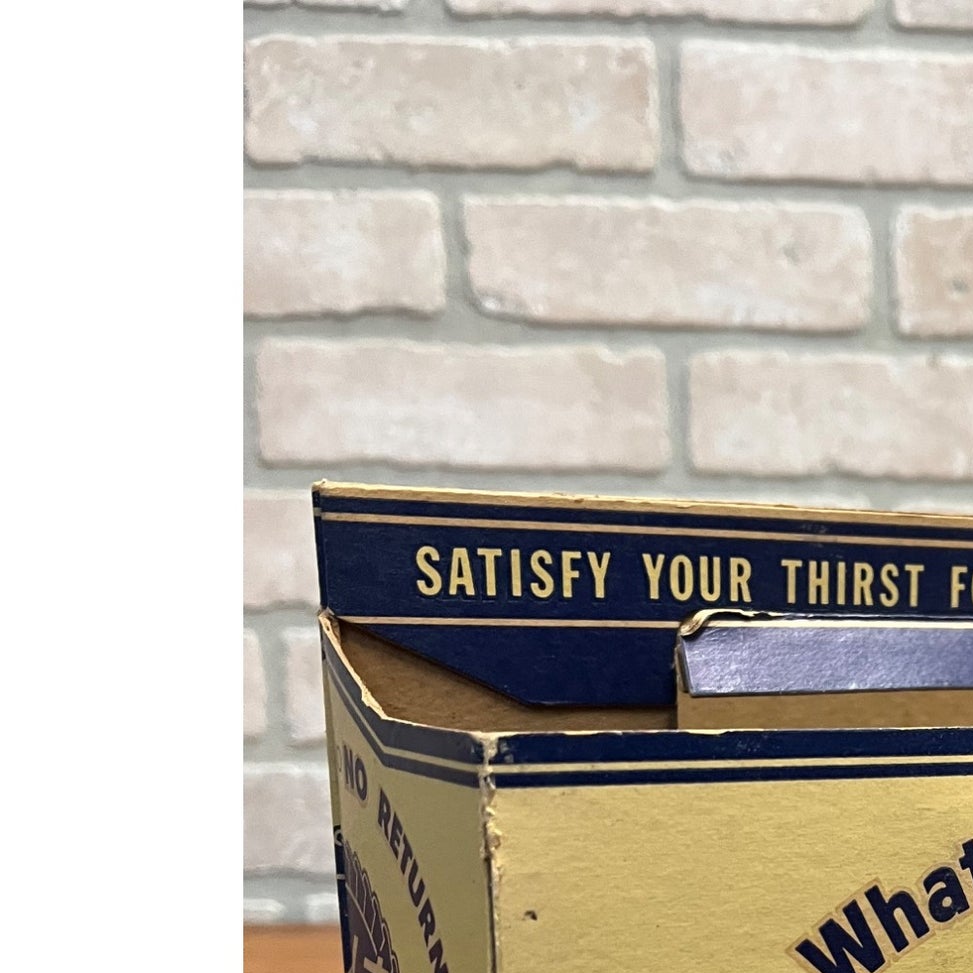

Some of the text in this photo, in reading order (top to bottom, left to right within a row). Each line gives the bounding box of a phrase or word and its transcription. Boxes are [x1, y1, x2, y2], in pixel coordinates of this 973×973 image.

[415, 545, 611, 599] SATISFY
[642, 552, 752, 603] YOUR
[781, 558, 925, 609] THIRST
[344, 745, 368, 801] NO
